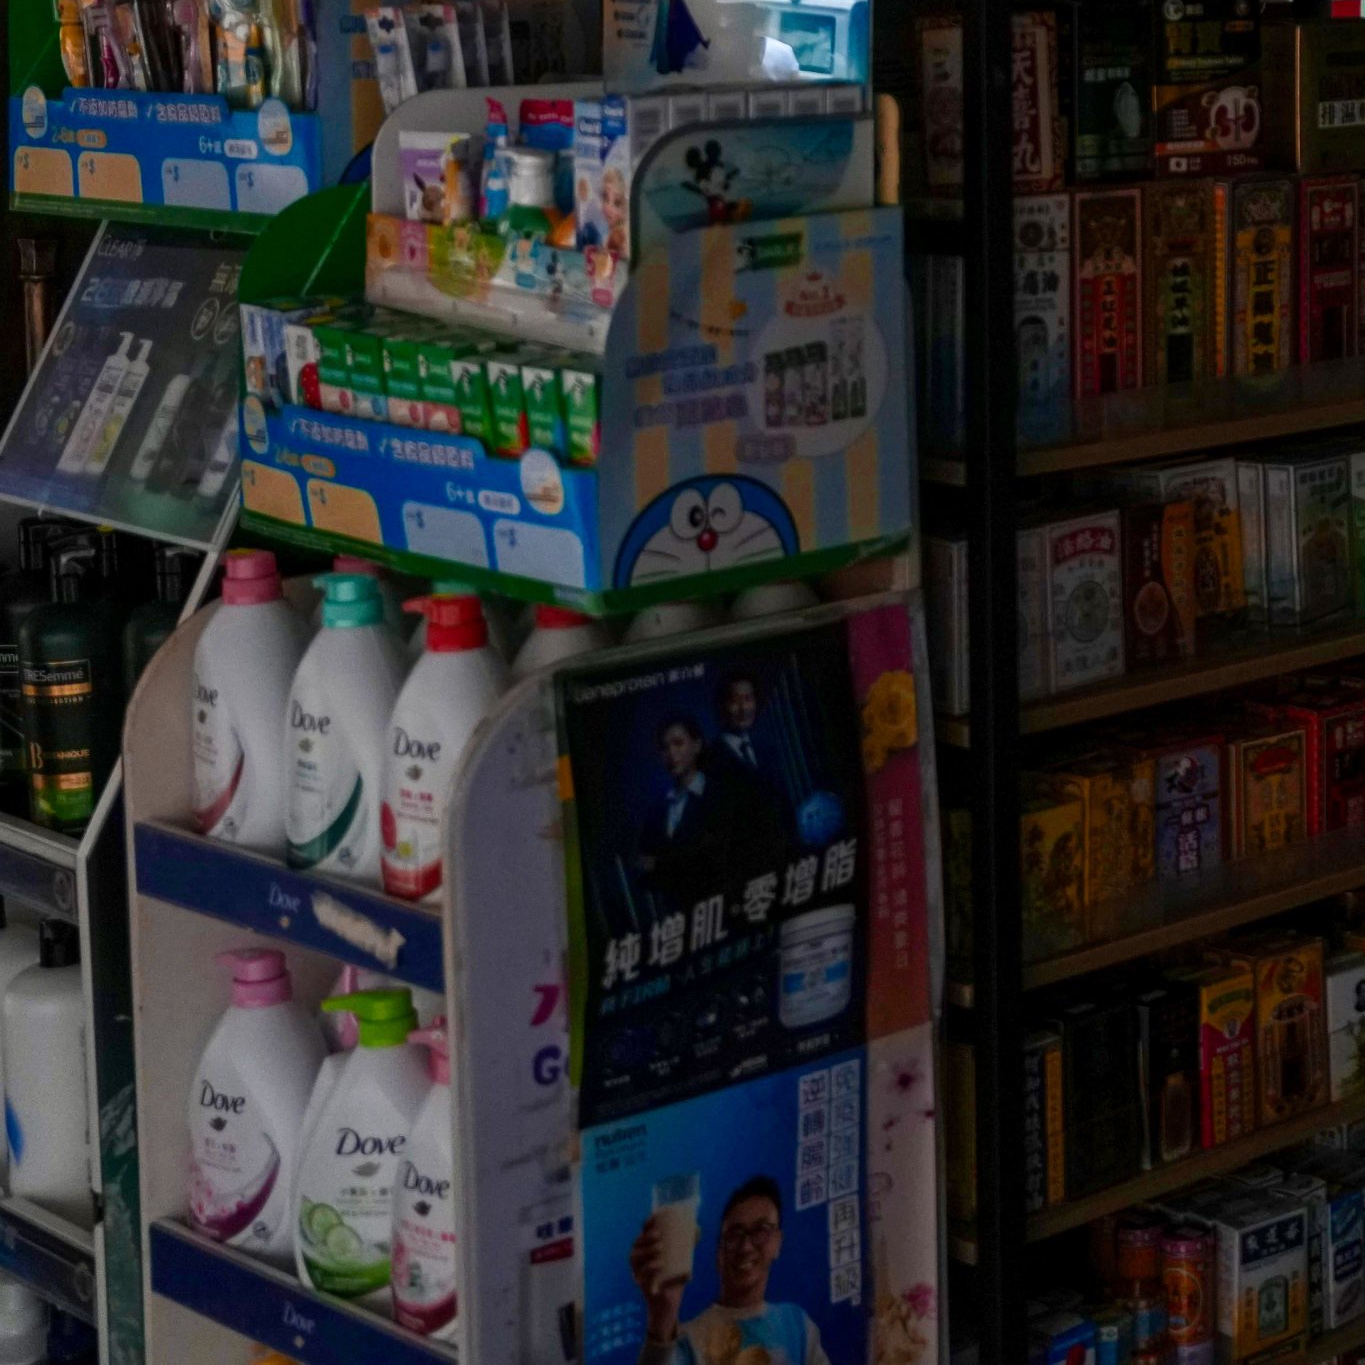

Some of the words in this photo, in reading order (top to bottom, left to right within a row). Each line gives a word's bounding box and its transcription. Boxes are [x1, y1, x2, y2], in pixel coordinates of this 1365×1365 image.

[290, 699, 332, 736] Dove
[393, 726, 443, 762] Dove
[268, 883, 301, 915] Dove
[199, 1079, 246, 1115] Dove
[335, 1126, 407, 1158] Dove
[402, 1160, 451, 1201] Dove
